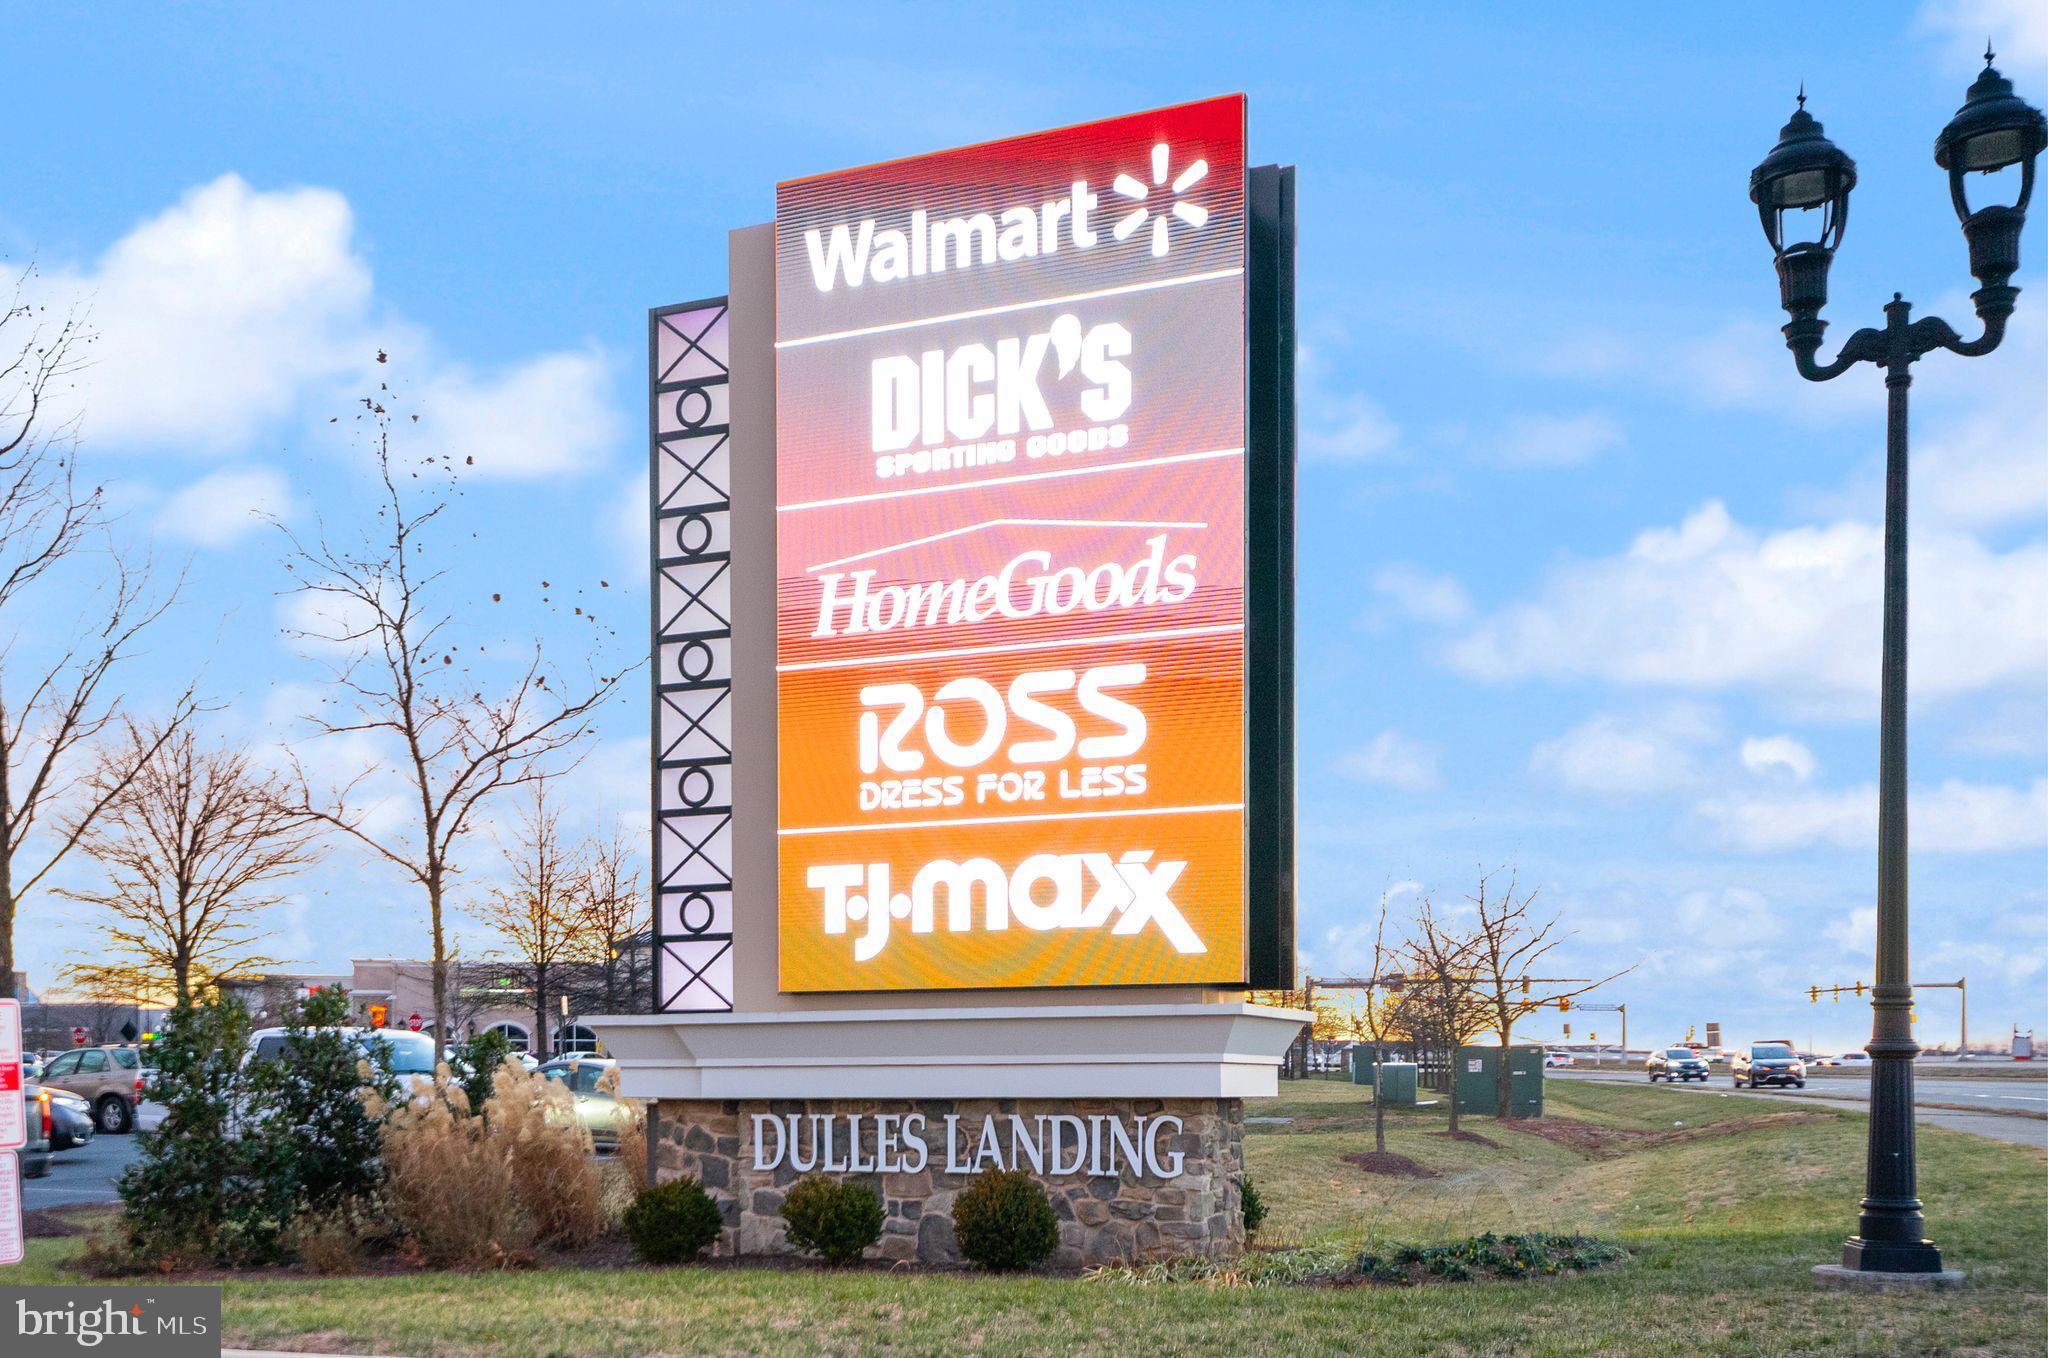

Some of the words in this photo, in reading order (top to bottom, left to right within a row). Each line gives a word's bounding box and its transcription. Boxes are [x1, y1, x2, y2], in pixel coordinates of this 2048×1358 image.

[805, 180, 1098, 292] Walmart
[871, 313, 1132, 452] DICK'S
[876, 439, 1016, 478] SPORTING
[1026, 424, 1129, 458] GOODS
[811, 533, 1197, 637] HomeGoods
[859, 663, 1147, 774] ROSS
[859, 776, 964, 811] DRESS
[977, 770, 1046, 803] FOR
[1059, 764, 1147, 799] LESS
[751, 1113, 929, 1174] DULLES
[944, 1113, 1186, 1178] LANDING
